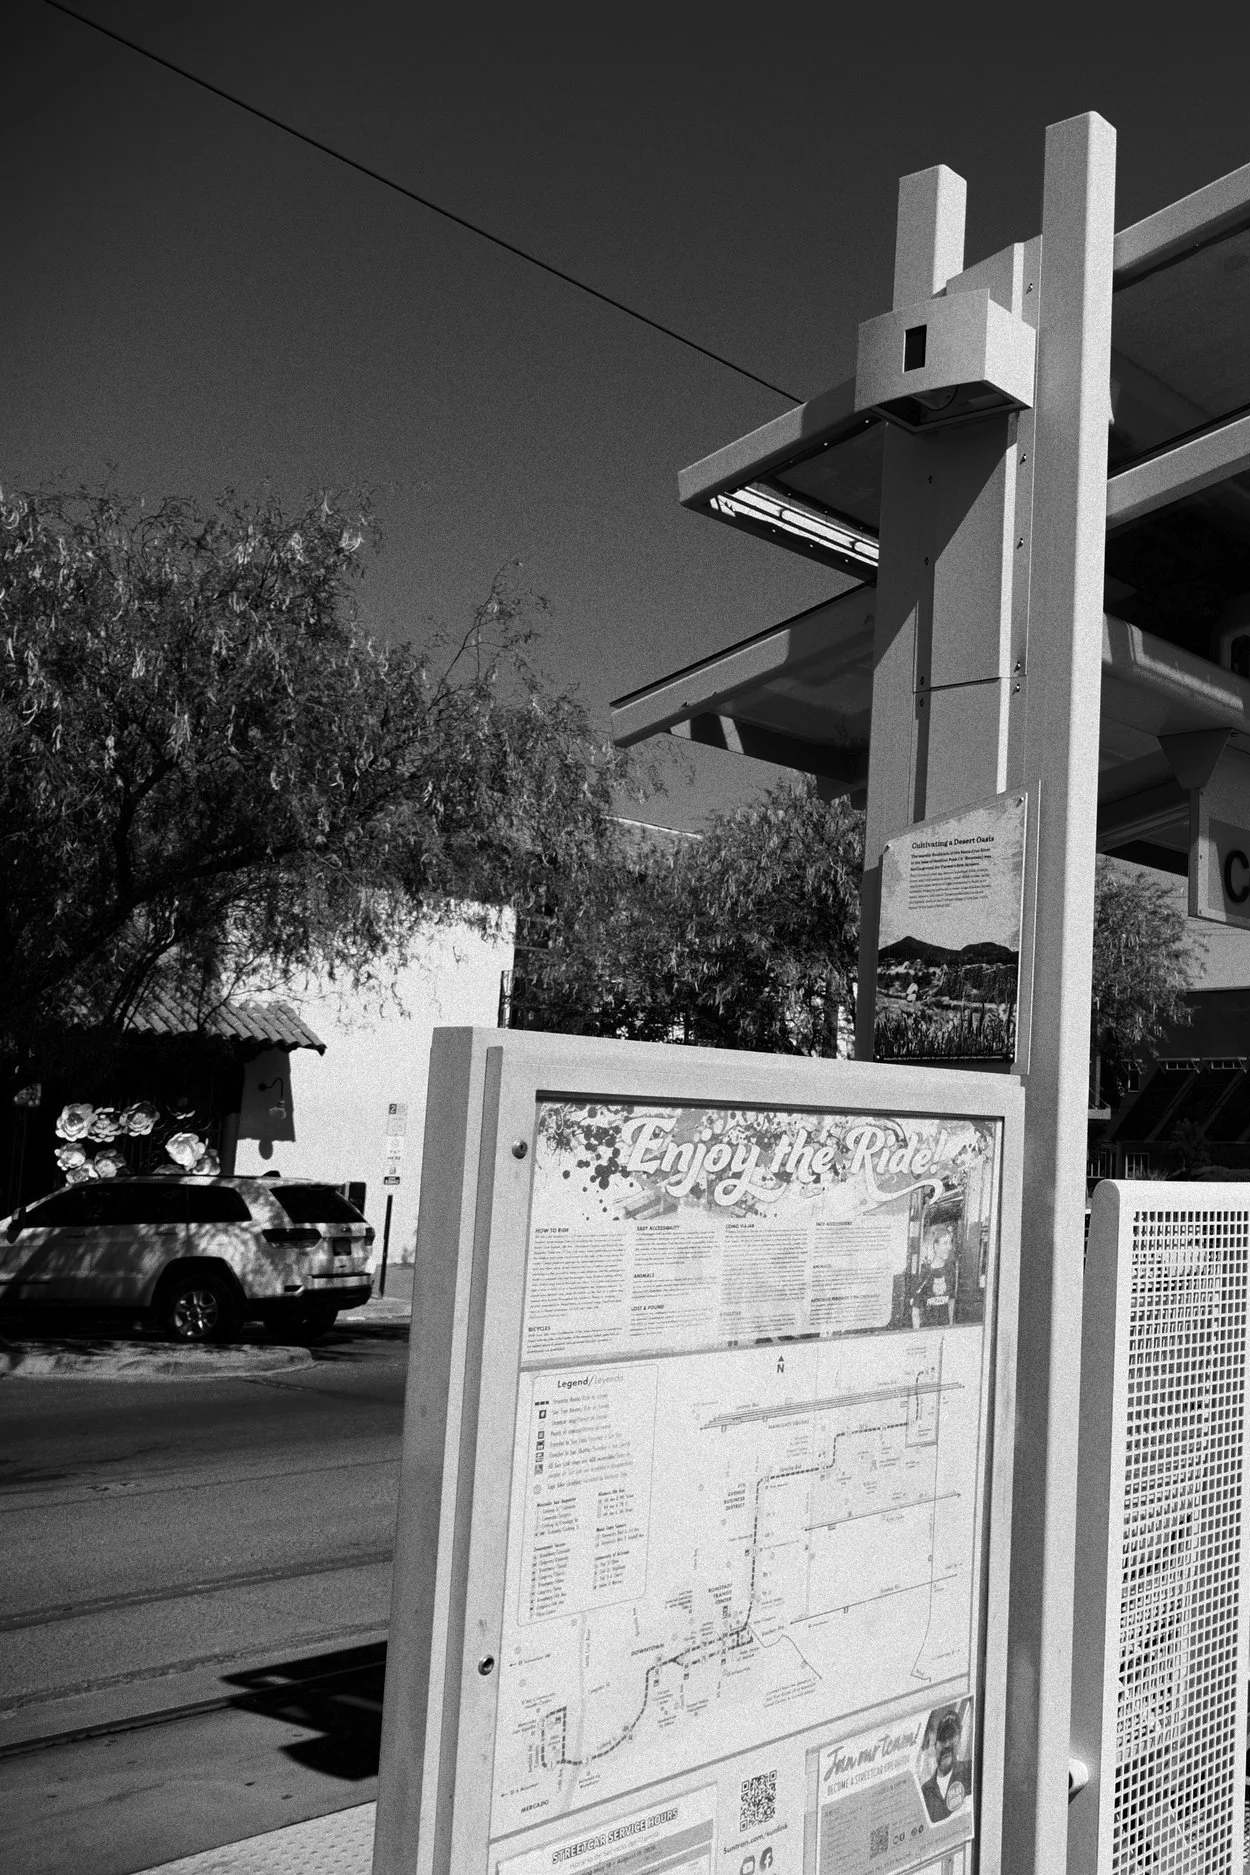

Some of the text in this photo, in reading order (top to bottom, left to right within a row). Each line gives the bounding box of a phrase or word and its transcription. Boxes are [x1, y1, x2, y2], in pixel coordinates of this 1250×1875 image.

[912, 840, 948, 849] Cultivating
[976, 835, 994, 843] Oasis
[621, 1117, 948, 1206] Enjoy the Ride!
[776, 1363, 785, 1373] N
[521, 1800, 549, 1812] MERCADO
[552, 1807, 678, 1865] STREETCAR SERVICE HOURS
